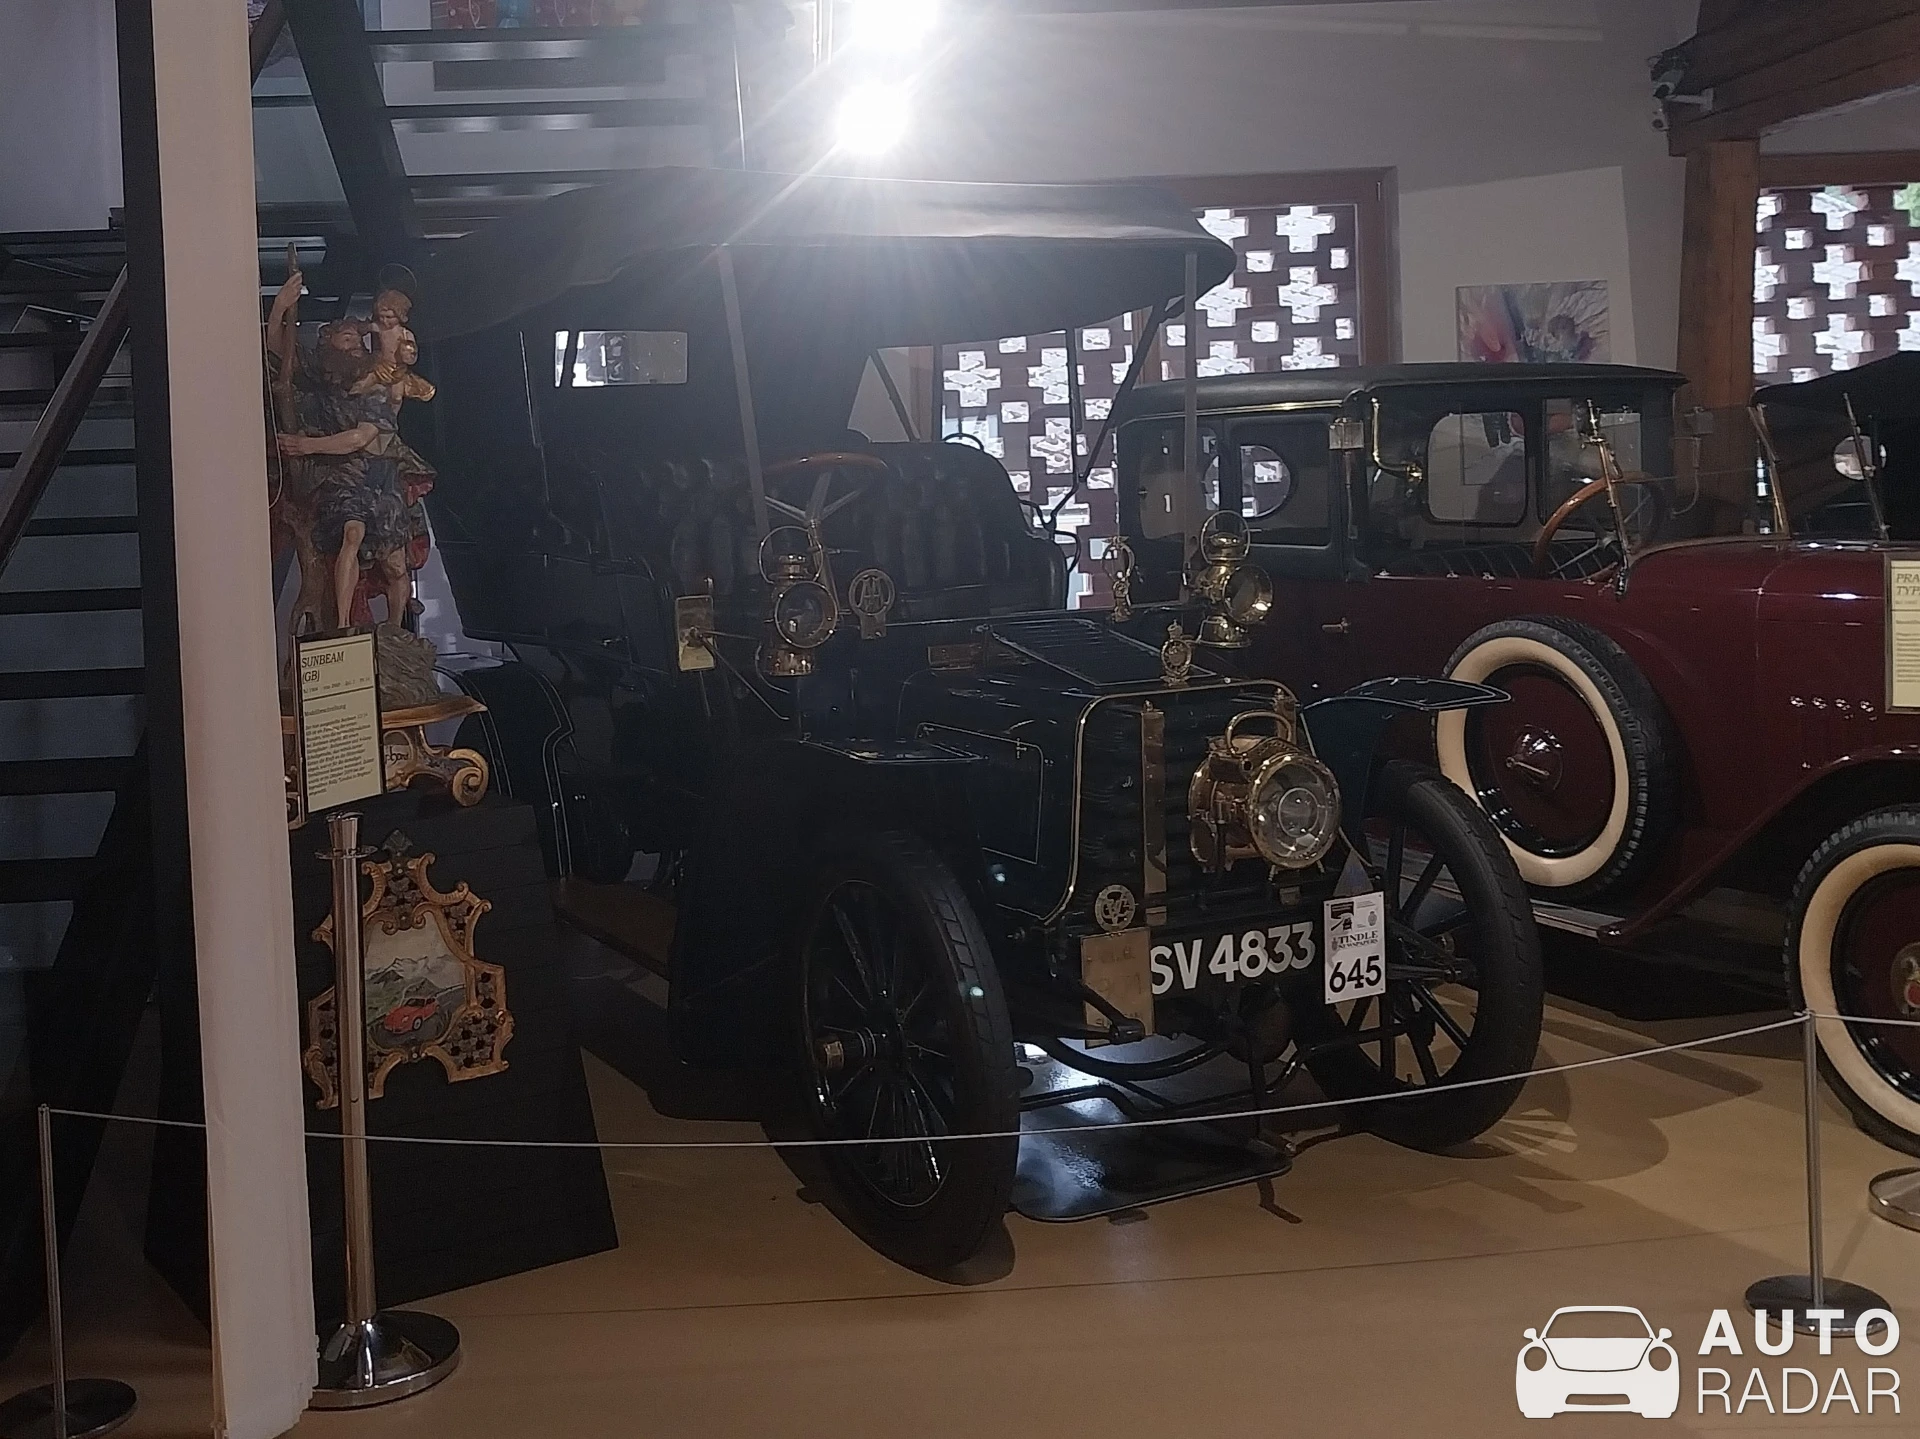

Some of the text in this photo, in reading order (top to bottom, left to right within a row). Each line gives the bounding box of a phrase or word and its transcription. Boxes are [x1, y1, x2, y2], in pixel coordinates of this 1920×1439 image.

[1896, 586, 1920, 596] TYP
[302, 651, 344, 668] SUNBEAM
[302, 670, 320, 684] (GB)
[1338, 930, 1378, 944] TINDLE
[1338, 938, 1378, 949] NEWSPAPERS
[1150, 921, 1316, 995] SV 4833
[1329, 955, 1382, 993] 645
